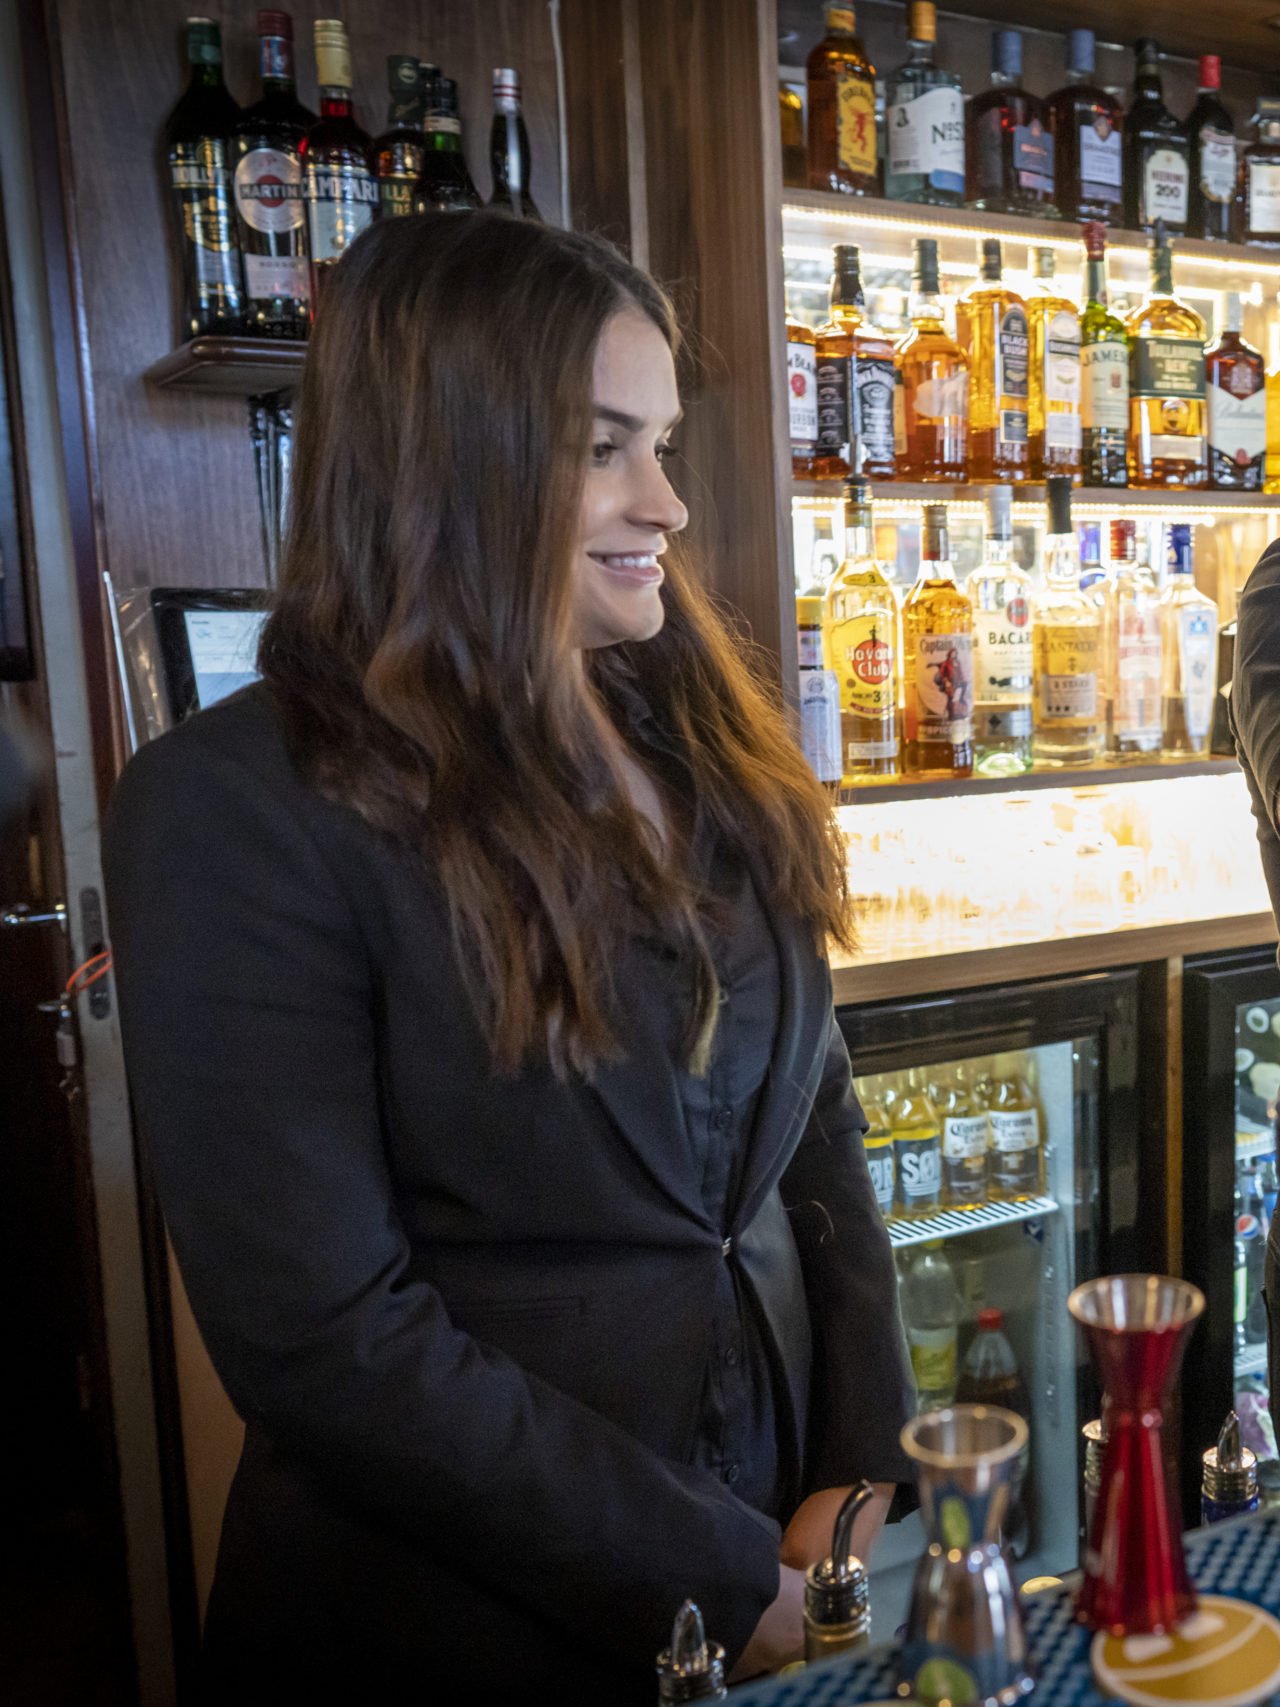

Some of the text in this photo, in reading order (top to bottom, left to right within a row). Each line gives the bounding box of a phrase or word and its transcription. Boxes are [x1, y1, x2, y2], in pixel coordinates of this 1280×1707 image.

[241, 183, 300, 199] MARTIN
[302, 174, 378, 202] CAMPARI
[1155, 183, 1181, 198] 200
[868, 574, 876, 584] 3
[858, 661, 888, 677] Club
[873, 690, 881, 703] 3
[901, 1149, 940, 1185] SØ
